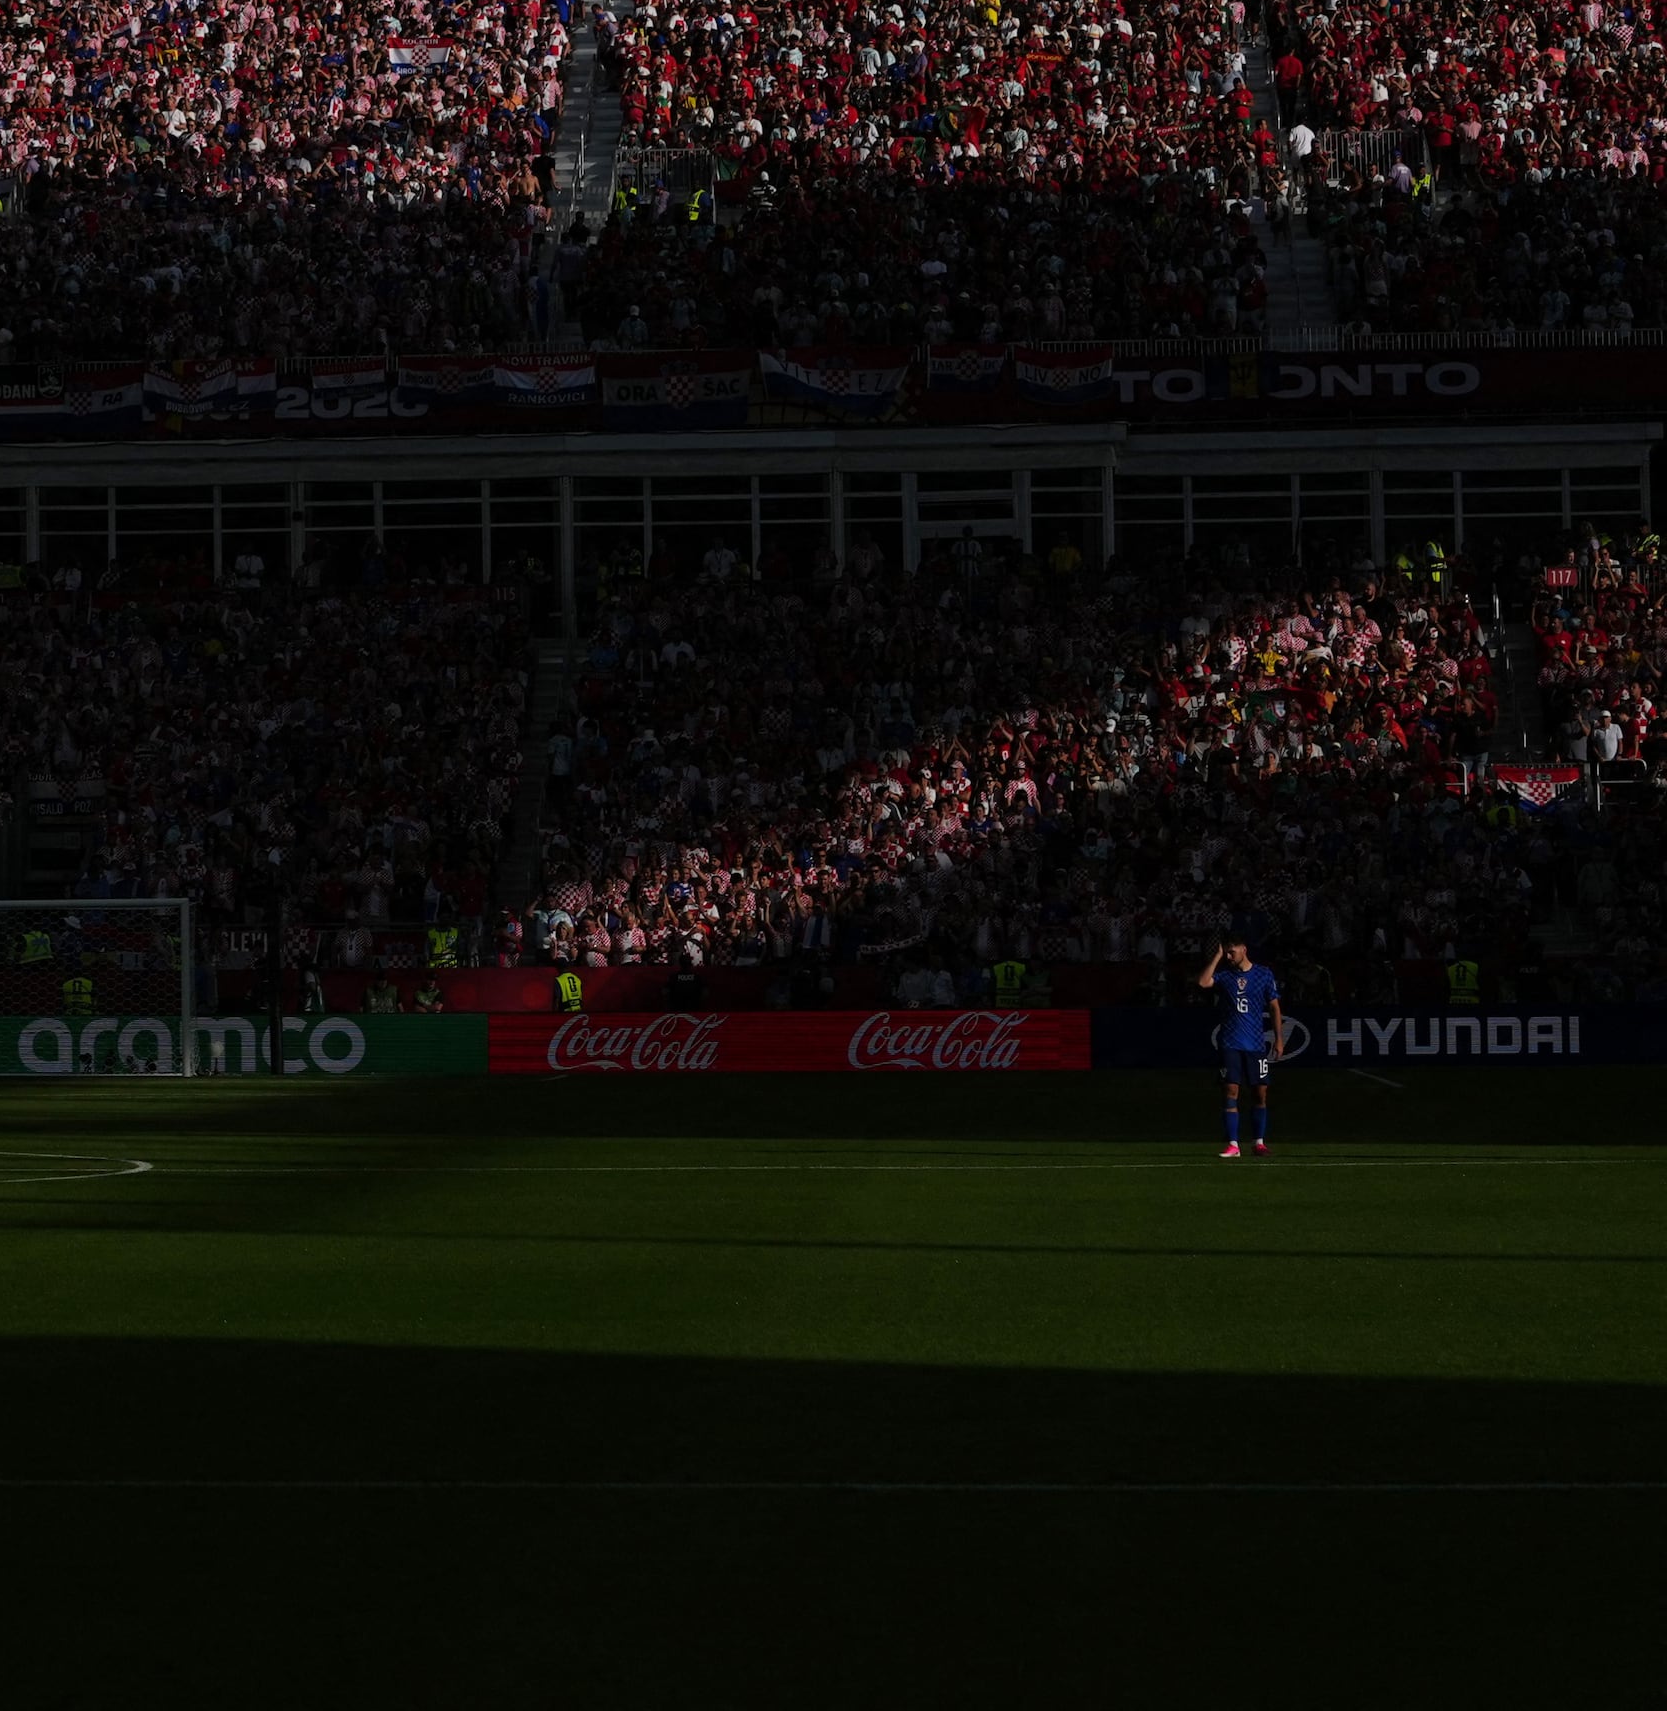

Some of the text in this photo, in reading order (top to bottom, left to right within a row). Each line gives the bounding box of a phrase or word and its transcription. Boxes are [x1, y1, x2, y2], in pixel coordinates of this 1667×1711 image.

[1112, 361, 1481, 404] TOONTO
[1551, 571, 1571, 584] 117
[1237, 999, 1249, 1014] 16
[17, 1016, 365, 1074] aramco
[547, 1013, 729, 1071] Coca-Cola
[848, 1012, 1029, 1069] Coca-Cola
[1327, 1016, 1579, 1055] HYUNDAI
[1259, 1059, 1269, 1073] 16
